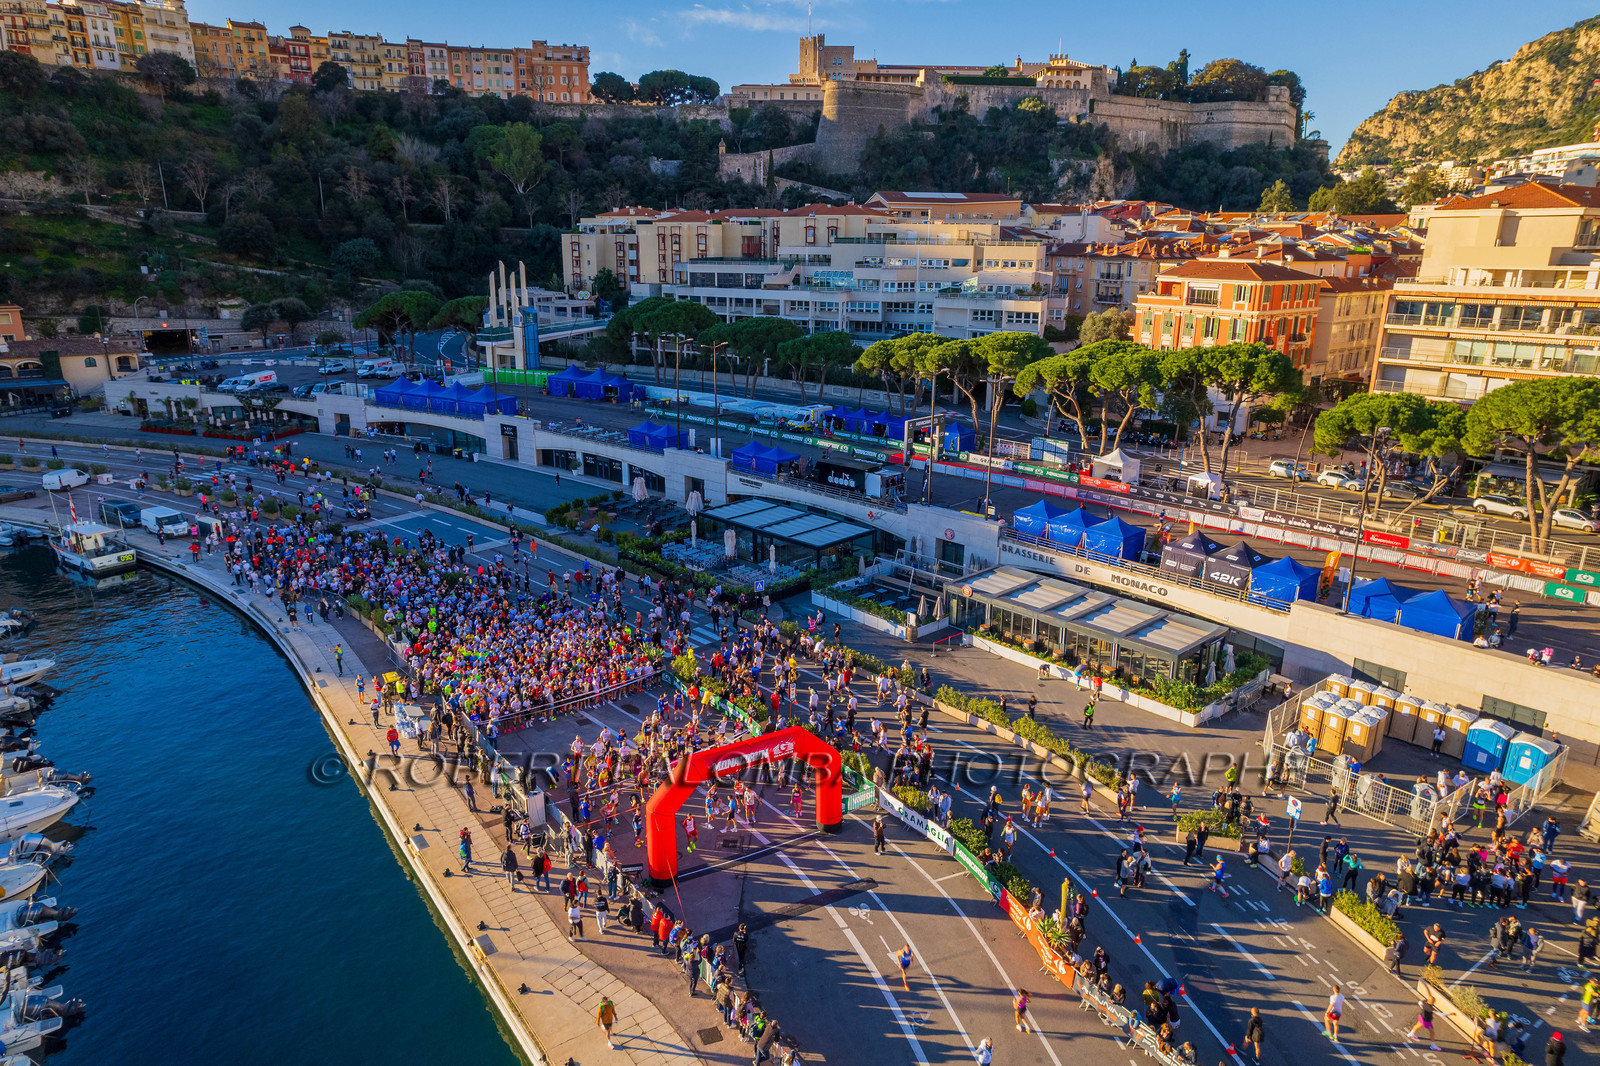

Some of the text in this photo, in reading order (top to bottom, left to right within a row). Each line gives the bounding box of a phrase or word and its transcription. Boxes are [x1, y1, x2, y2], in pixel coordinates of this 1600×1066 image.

[1001, 543, 1169, 597] BRASSERIE DE MONACO
[1210, 572, 1241, 587] 42K
